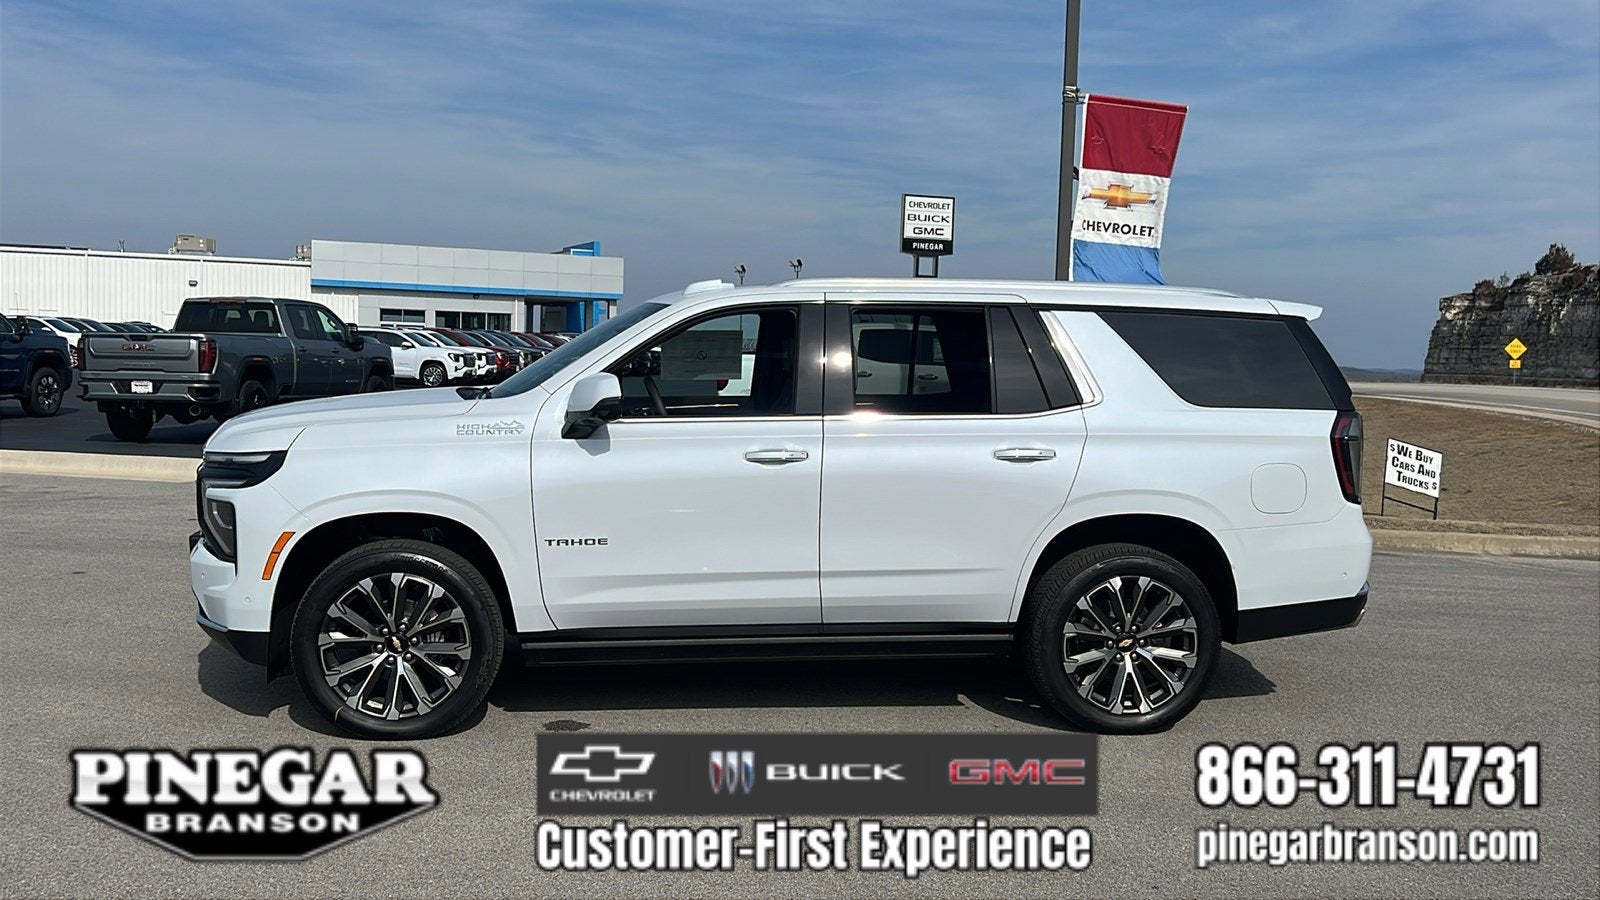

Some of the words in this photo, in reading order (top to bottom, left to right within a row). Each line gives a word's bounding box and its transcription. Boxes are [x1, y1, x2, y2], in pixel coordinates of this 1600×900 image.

[908, 201, 951, 210] CHEVROLET
[907, 213, 951, 224] BUICK
[912, 226, 944, 236] GMC
[1081, 219, 1155, 237] CHEVROLET
[912, 242, 944, 251] PINEGAR
[544, 537, 609, 547] TAHOE
